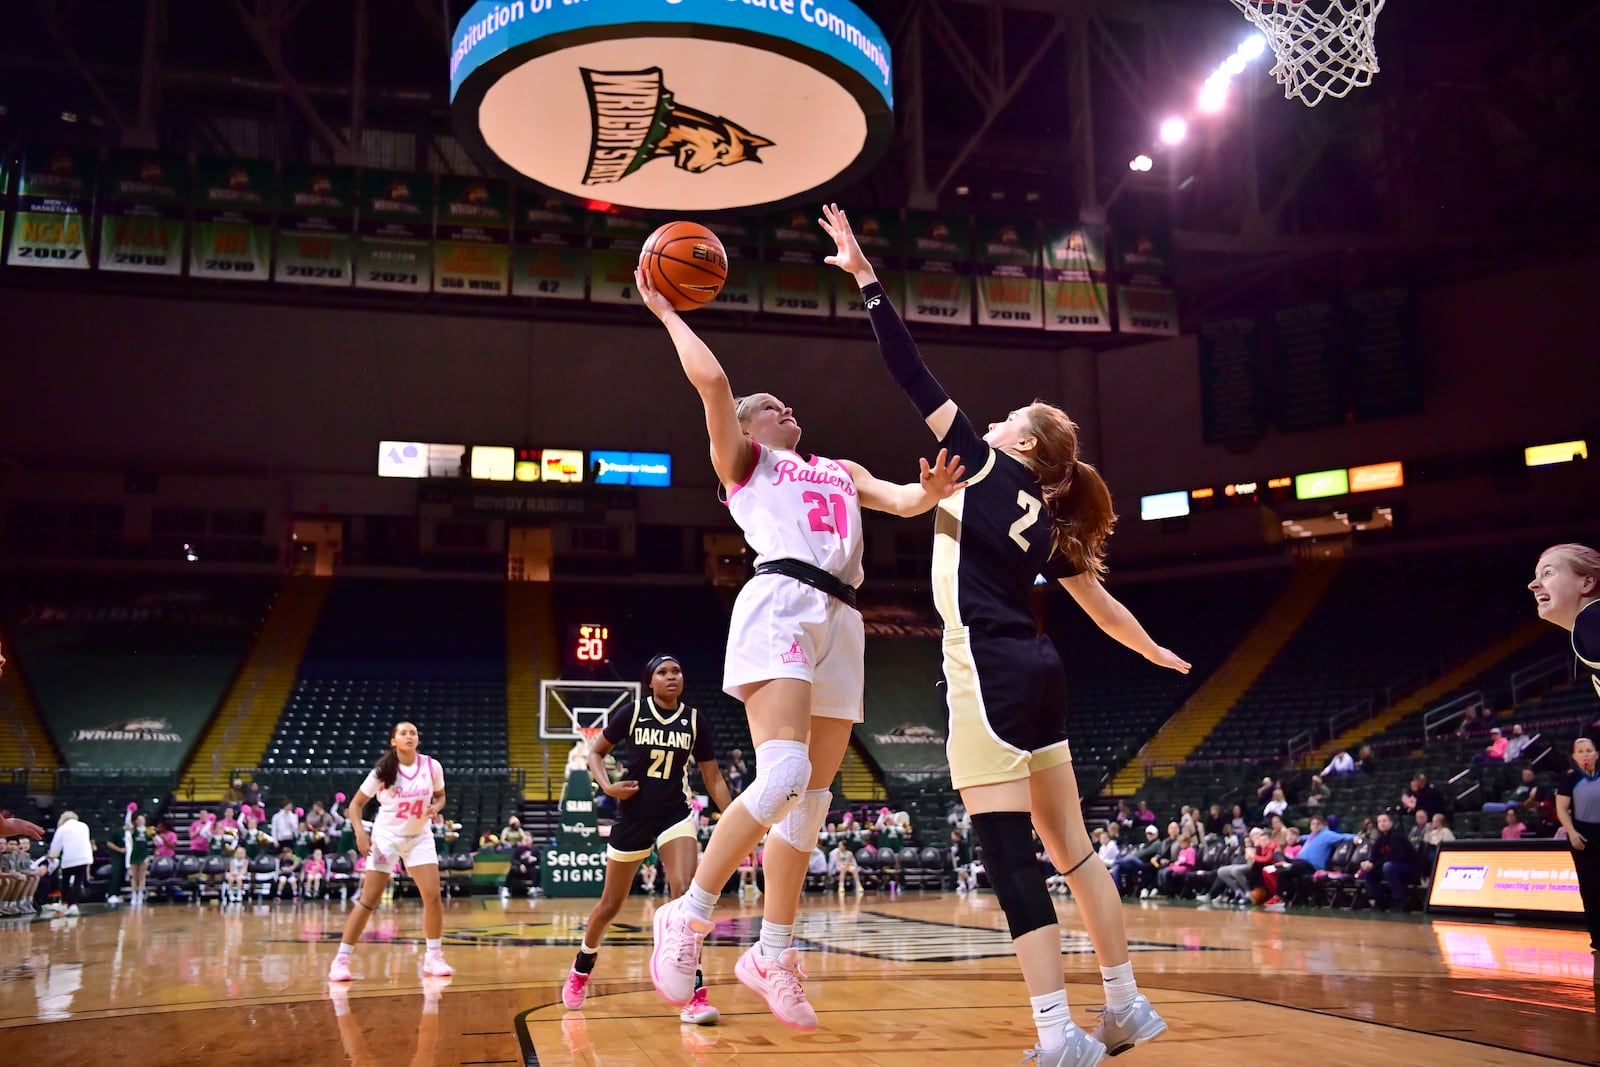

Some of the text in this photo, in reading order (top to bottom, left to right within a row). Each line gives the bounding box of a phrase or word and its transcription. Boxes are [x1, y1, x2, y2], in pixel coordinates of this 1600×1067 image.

[801, 0, 889, 86] Community
[589, 71, 660, 148] WRIGHT
[23, 221, 81, 244] NCAA
[18, 247, 82, 260] 2007
[286, 265, 342, 279] 2020
[369, 271, 418, 285] 2021
[539, 280, 560, 293] 42
[715, 294, 749, 304] 014
[918, 305, 958, 317] 2017
[609, 462, 668, 474] Premier Health
[773, 459, 856, 496] Raiders
[802, 490, 848, 540] 21
[1008, 489, 1042, 552] 2
[577, 638, 602, 660] 20
[76, 729, 143, 741] WRIGHT
[634, 727, 691, 750] OAKLAND
[647, 748, 674, 779] 21
[391, 786, 430, 799] Raiders
[395, 800, 424, 819] 24
[547, 850, 608, 867] Select
[553, 869, 604, 882] SIGNS
[1531, 884, 1547, 892] your
